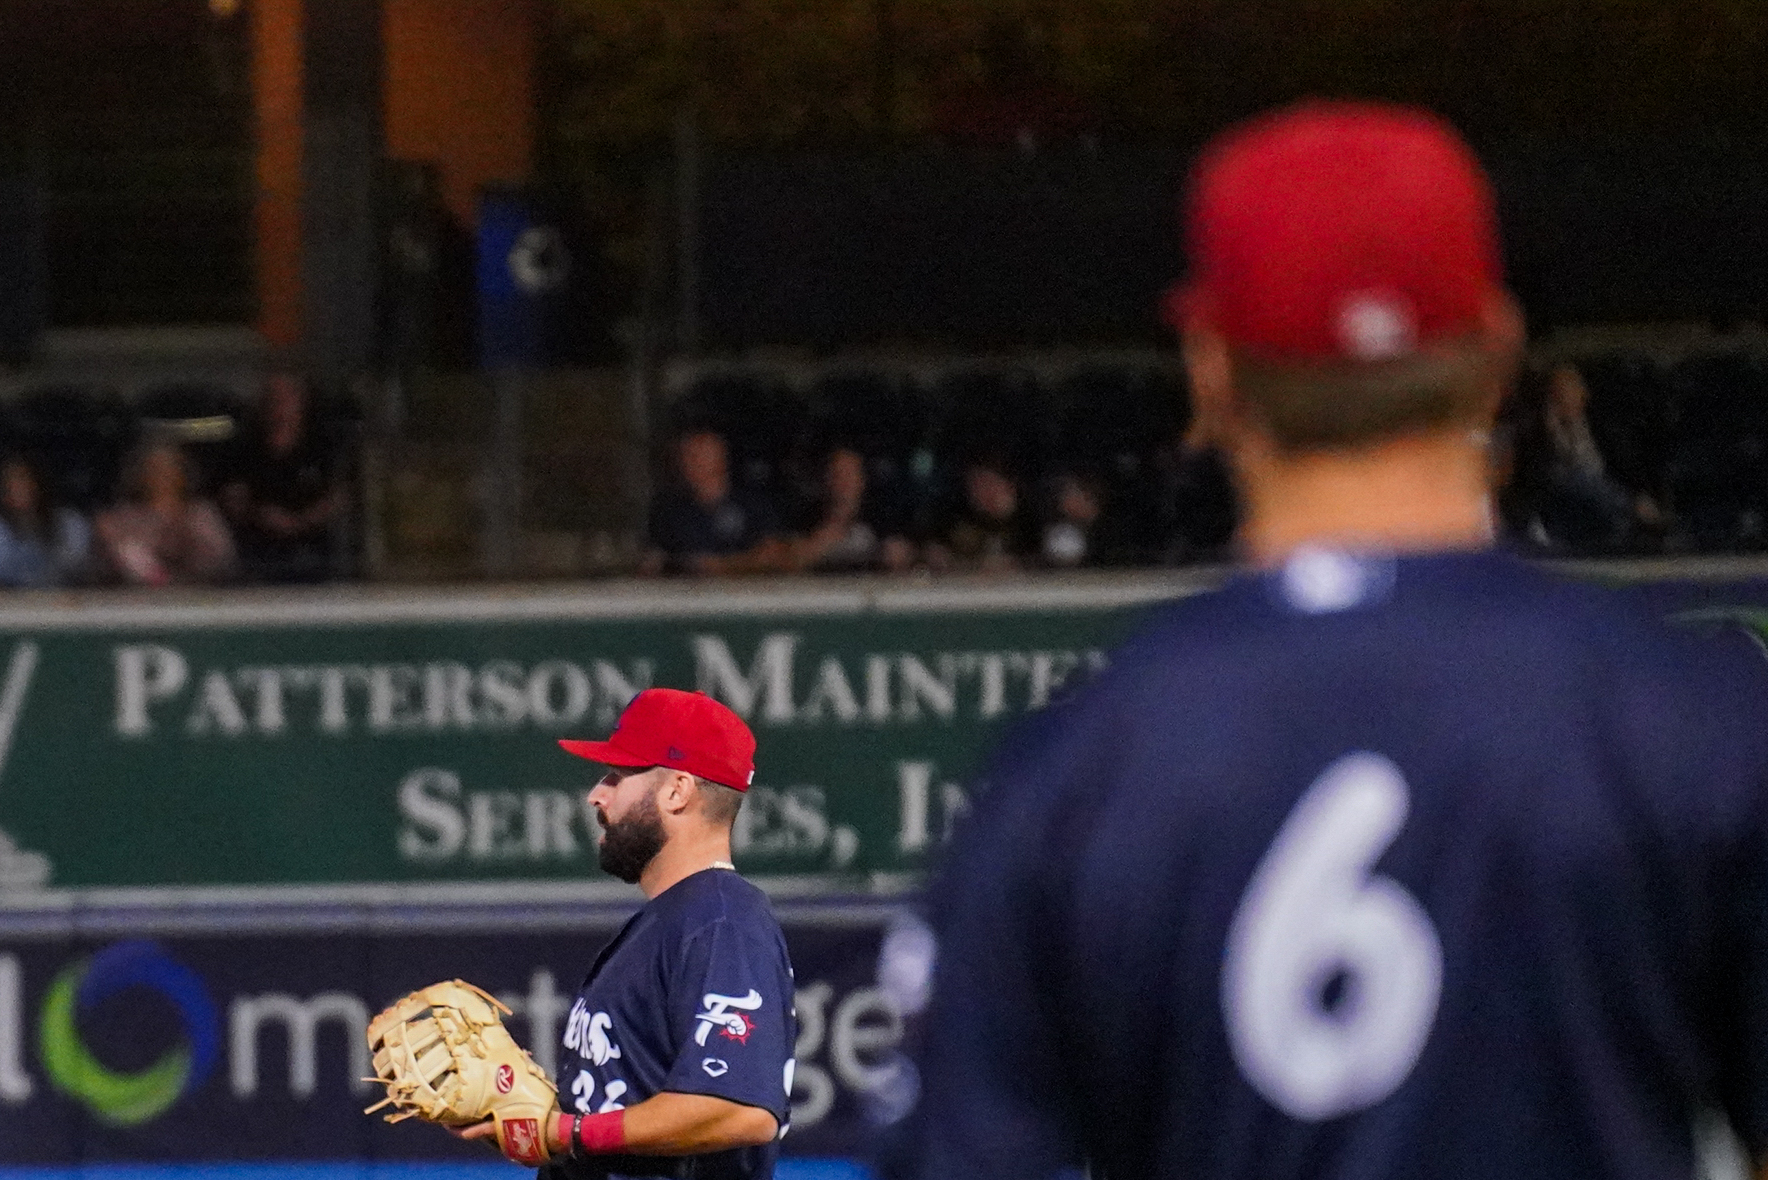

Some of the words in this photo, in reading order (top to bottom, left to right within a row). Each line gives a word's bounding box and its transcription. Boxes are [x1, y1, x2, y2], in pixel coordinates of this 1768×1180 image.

[113, 644, 656, 737] PATTERSON
[692, 632, 1107, 724] MAINTE
[395, 766, 859, 866] SERES,
[1220, 750, 1443, 1122] 6
